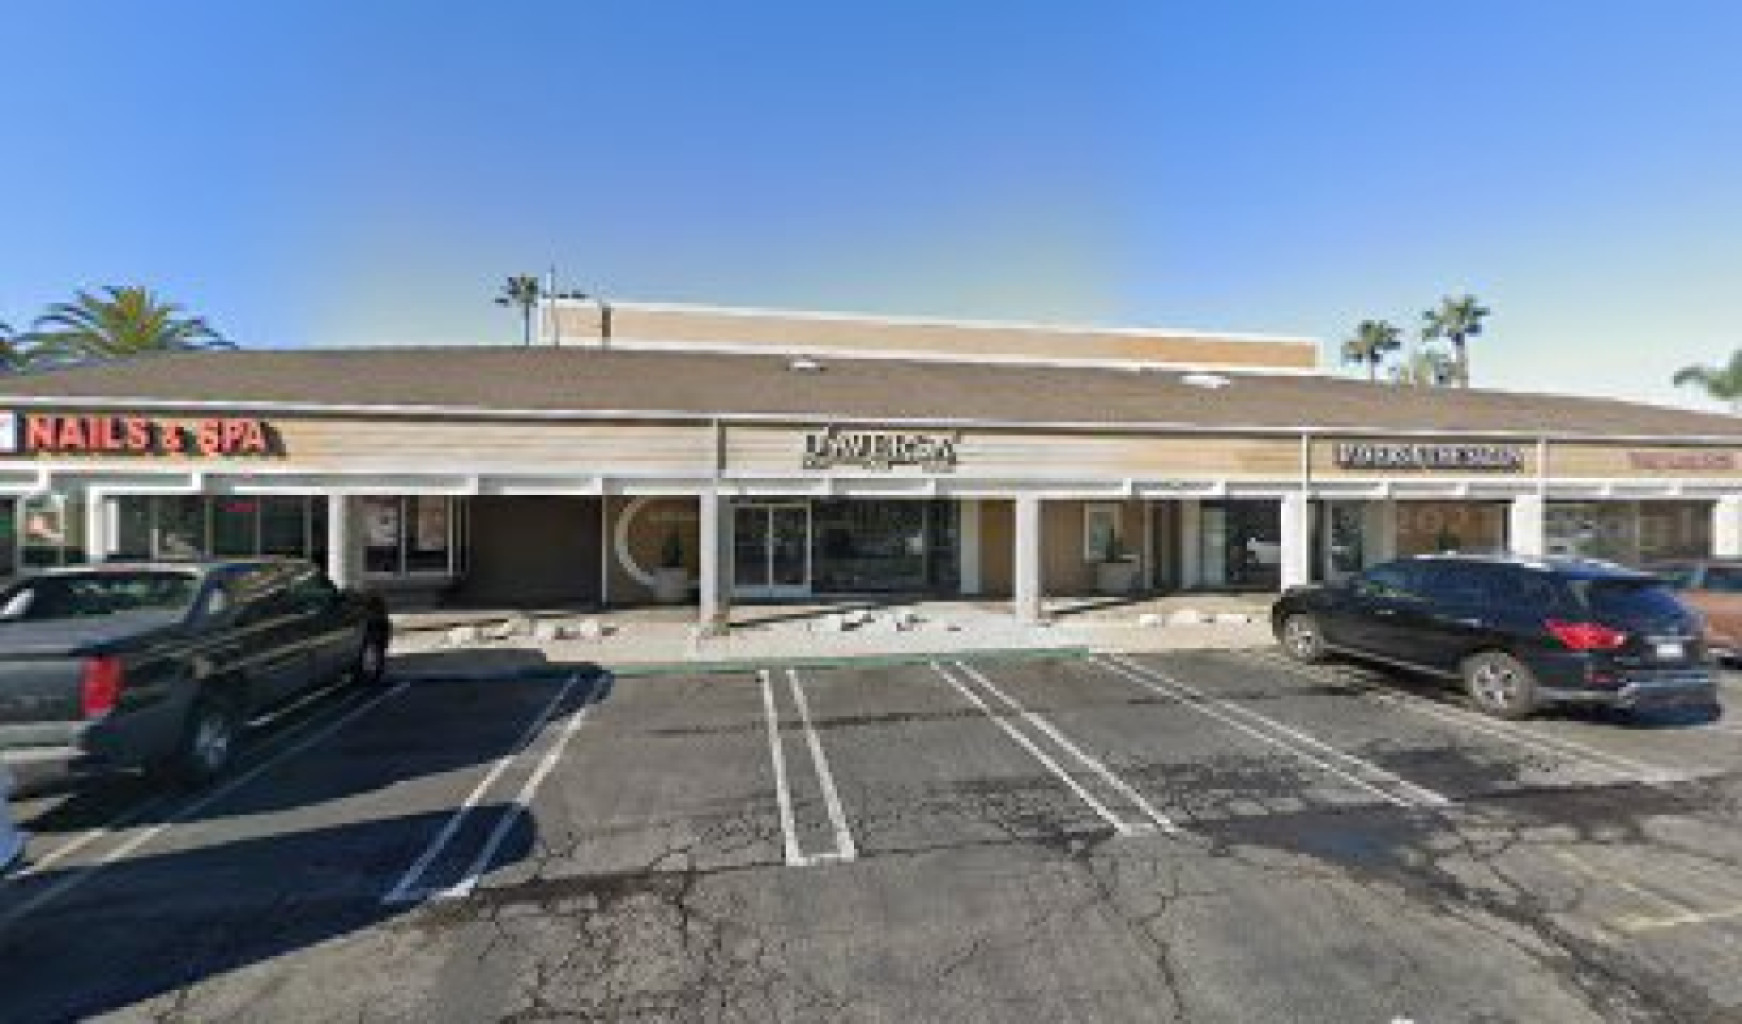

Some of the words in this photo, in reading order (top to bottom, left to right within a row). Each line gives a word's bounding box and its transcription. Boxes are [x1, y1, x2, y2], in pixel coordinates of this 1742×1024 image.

[27, 414, 148, 450] NAILS
[163, 419, 186, 450] &
[199, 416, 267, 453] SPA
